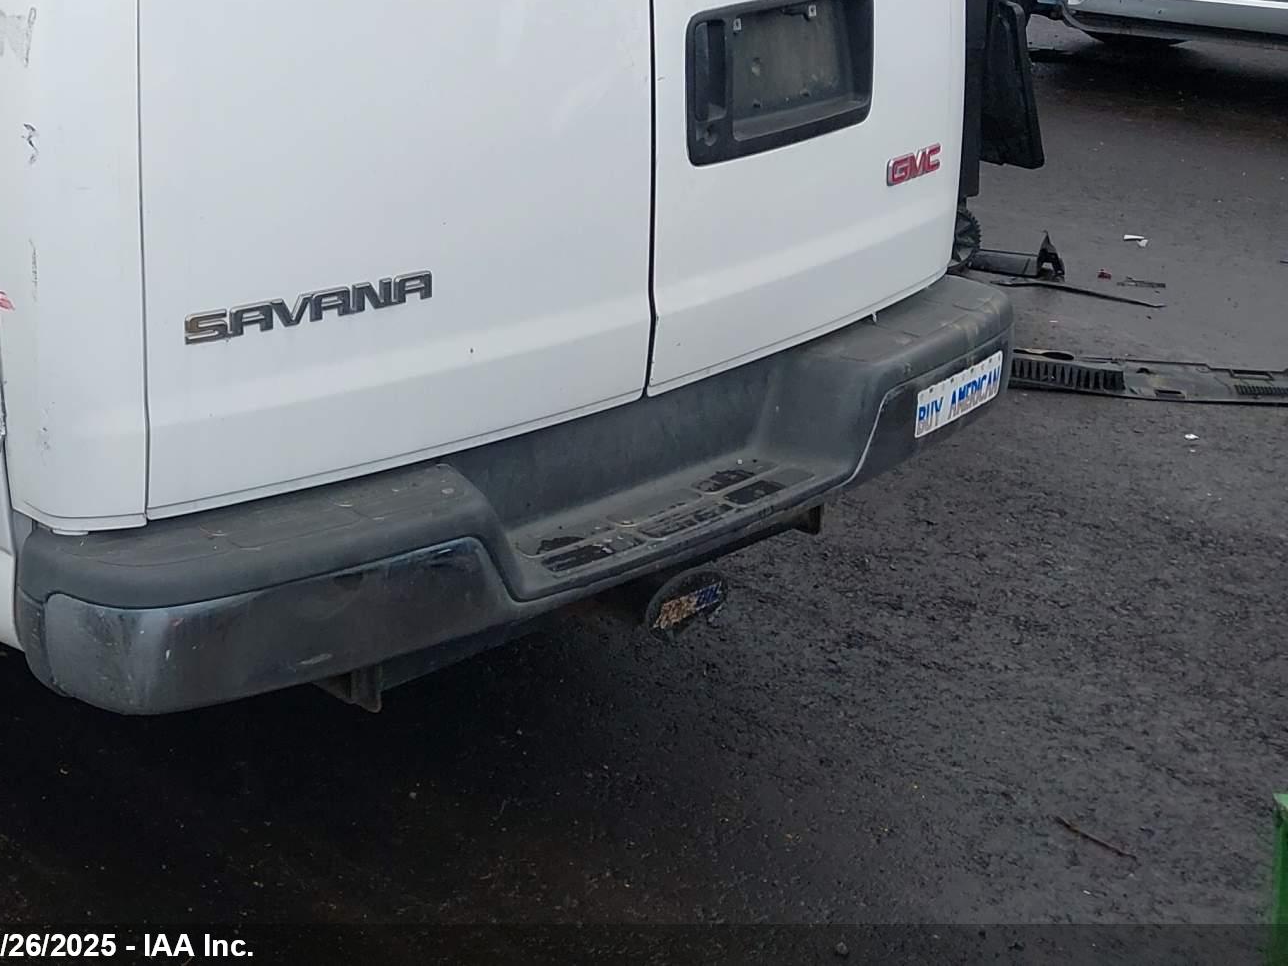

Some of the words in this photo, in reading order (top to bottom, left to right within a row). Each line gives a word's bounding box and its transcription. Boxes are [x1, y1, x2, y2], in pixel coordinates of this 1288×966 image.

[886, 142, 941, 186] GMC
[184, 270, 433, 345] SAVANA
[917, 395, 944, 433] BUY
[947, 365, 1001, 421] AMERICAN
